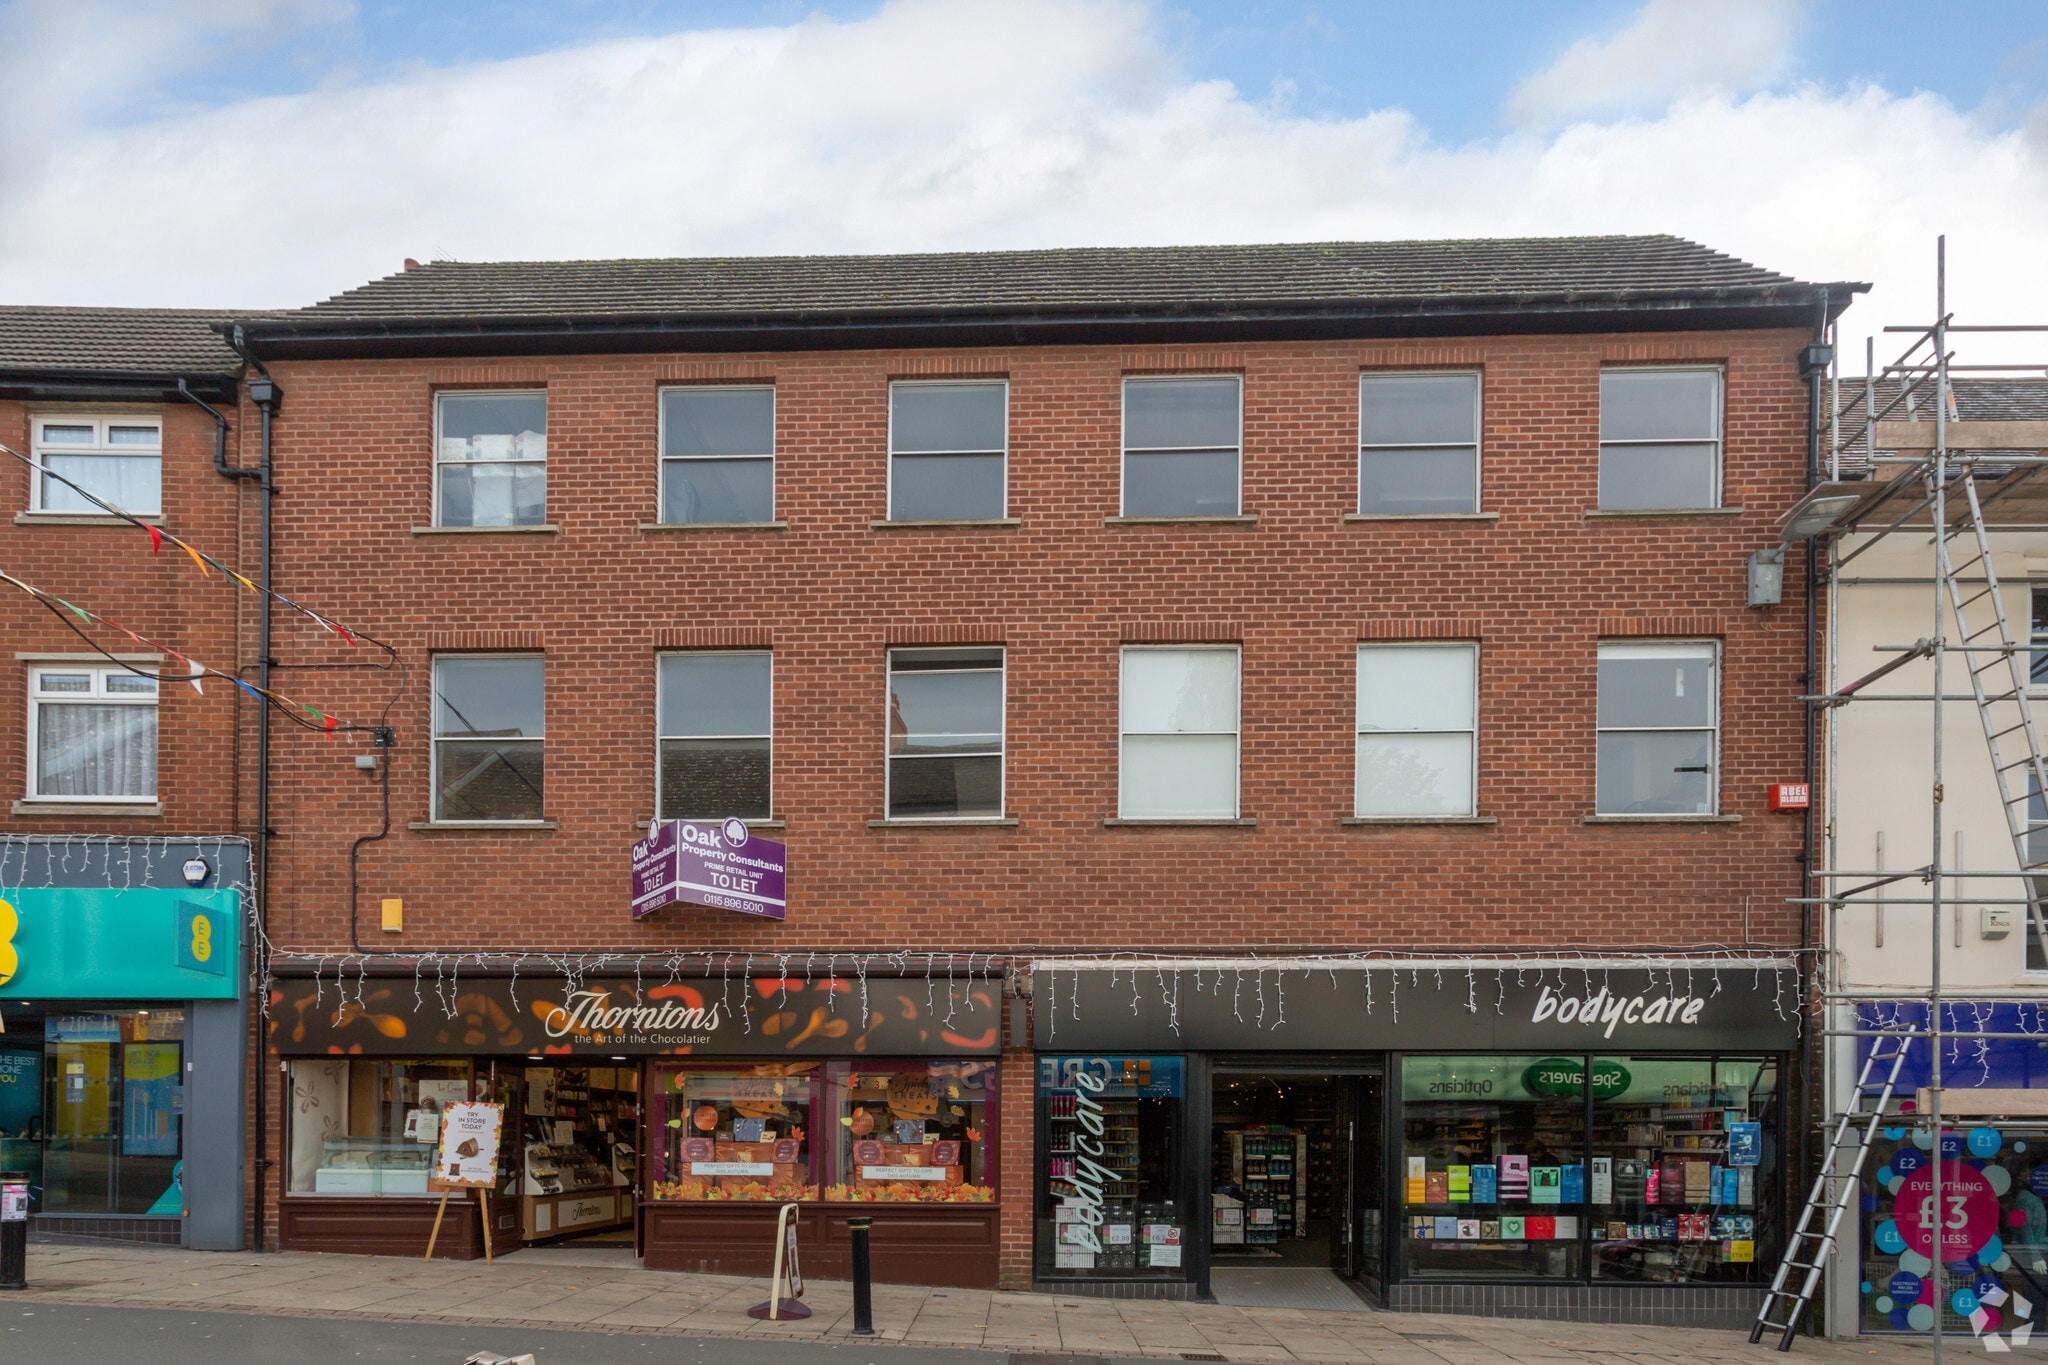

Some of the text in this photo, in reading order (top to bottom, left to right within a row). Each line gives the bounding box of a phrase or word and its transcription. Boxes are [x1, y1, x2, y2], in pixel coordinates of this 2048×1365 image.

[1781, 786, 1806, 796] ABEL
[682, 824, 722, 848] Oak
[633, 841, 648, 862] Oak
[633, 844, 676, 872] Property Consultants
[682, 842, 784, 873] Property Consultants
[704, 862, 764, 880] PRIME RETAIL UNIT
[643, 878, 652, 893] TO
[652, 872, 664, 889] LET
[710, 872, 758, 892] TO LET
[704, 894, 723, 906] 0115
[724, 896, 742, 909] 896
[743, 900, 764, 913] 5010
[545, 990, 720, 1038] Thorntons
[1532, 986, 1704, 1039] bodycare
[574, 1034, 710, 1044] the Art of the Chocolatier
[14, 1056, 36, 1066] BEST
[893, 1092, 937, 1100] TREATS
[1942, 1141, 1956, 1152] £2
[1976, 1136, 1992, 1147] £1
[1064, 1072, 1122, 1254] bodycare
[1900, 1158, 1916, 1169] £2
[1911, 1182, 1982, 1192] EVEYTHING
[1919, 1196, 1968, 1230] £3
[1884, 1232, 1900, 1242] £1
[1942, 1234, 1968, 1244] LESS
[1979, 1282, 1996, 1294] £2
[1958, 1297, 1973, 1308] £1
